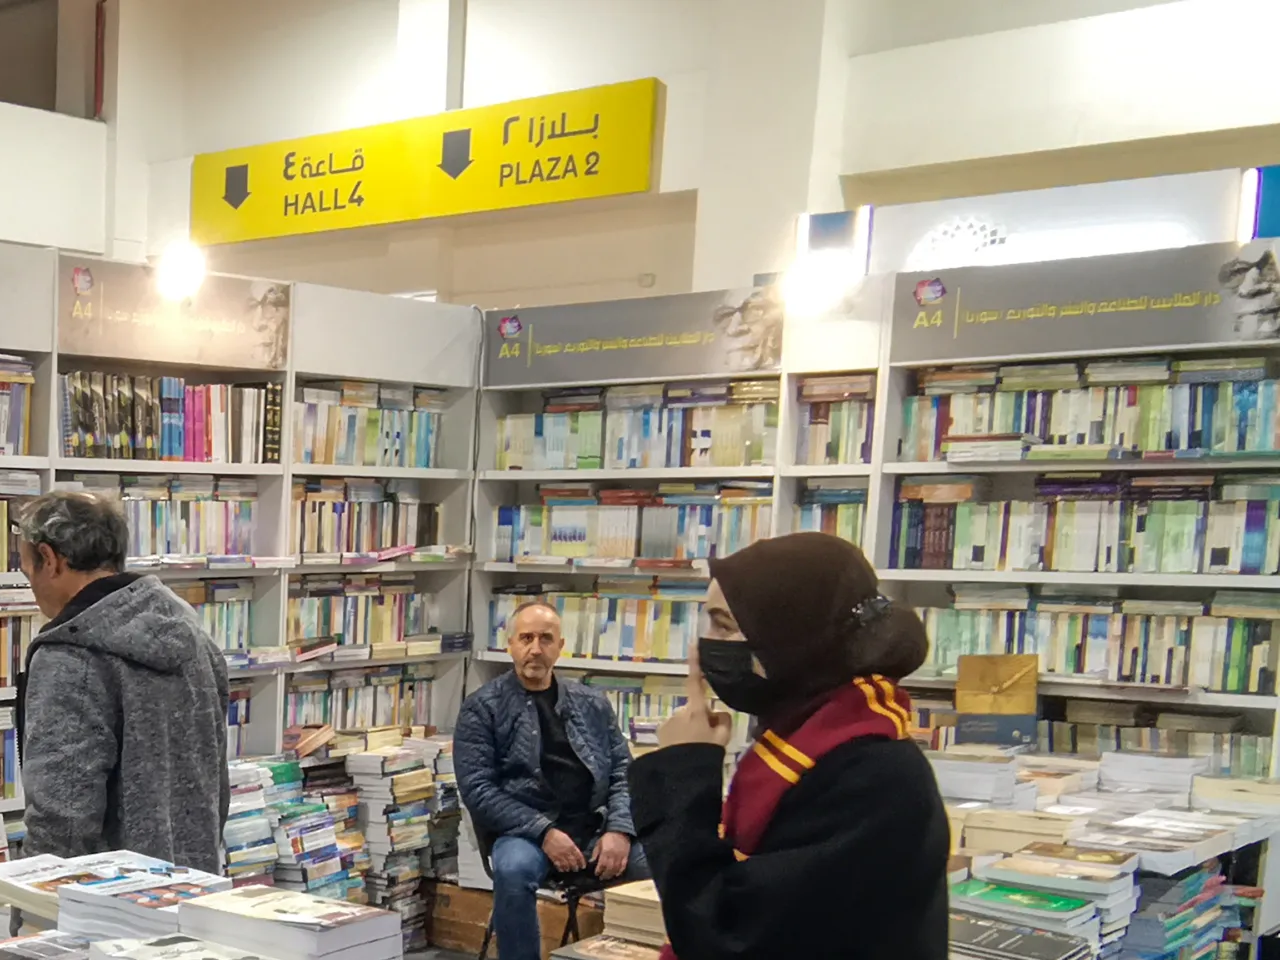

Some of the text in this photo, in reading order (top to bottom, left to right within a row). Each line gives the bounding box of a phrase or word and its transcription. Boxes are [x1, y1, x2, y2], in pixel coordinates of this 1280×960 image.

[528, 112, 600, 148] بلازا
[301, 148, 364, 180] قاعة
[499, 150, 600, 188] PLAZA 2
[283, 188, 347, 216] HALL
[72, 300, 93, 320] A4
[913, 309, 943, 329] A4
[498, 341, 520, 359] A4
